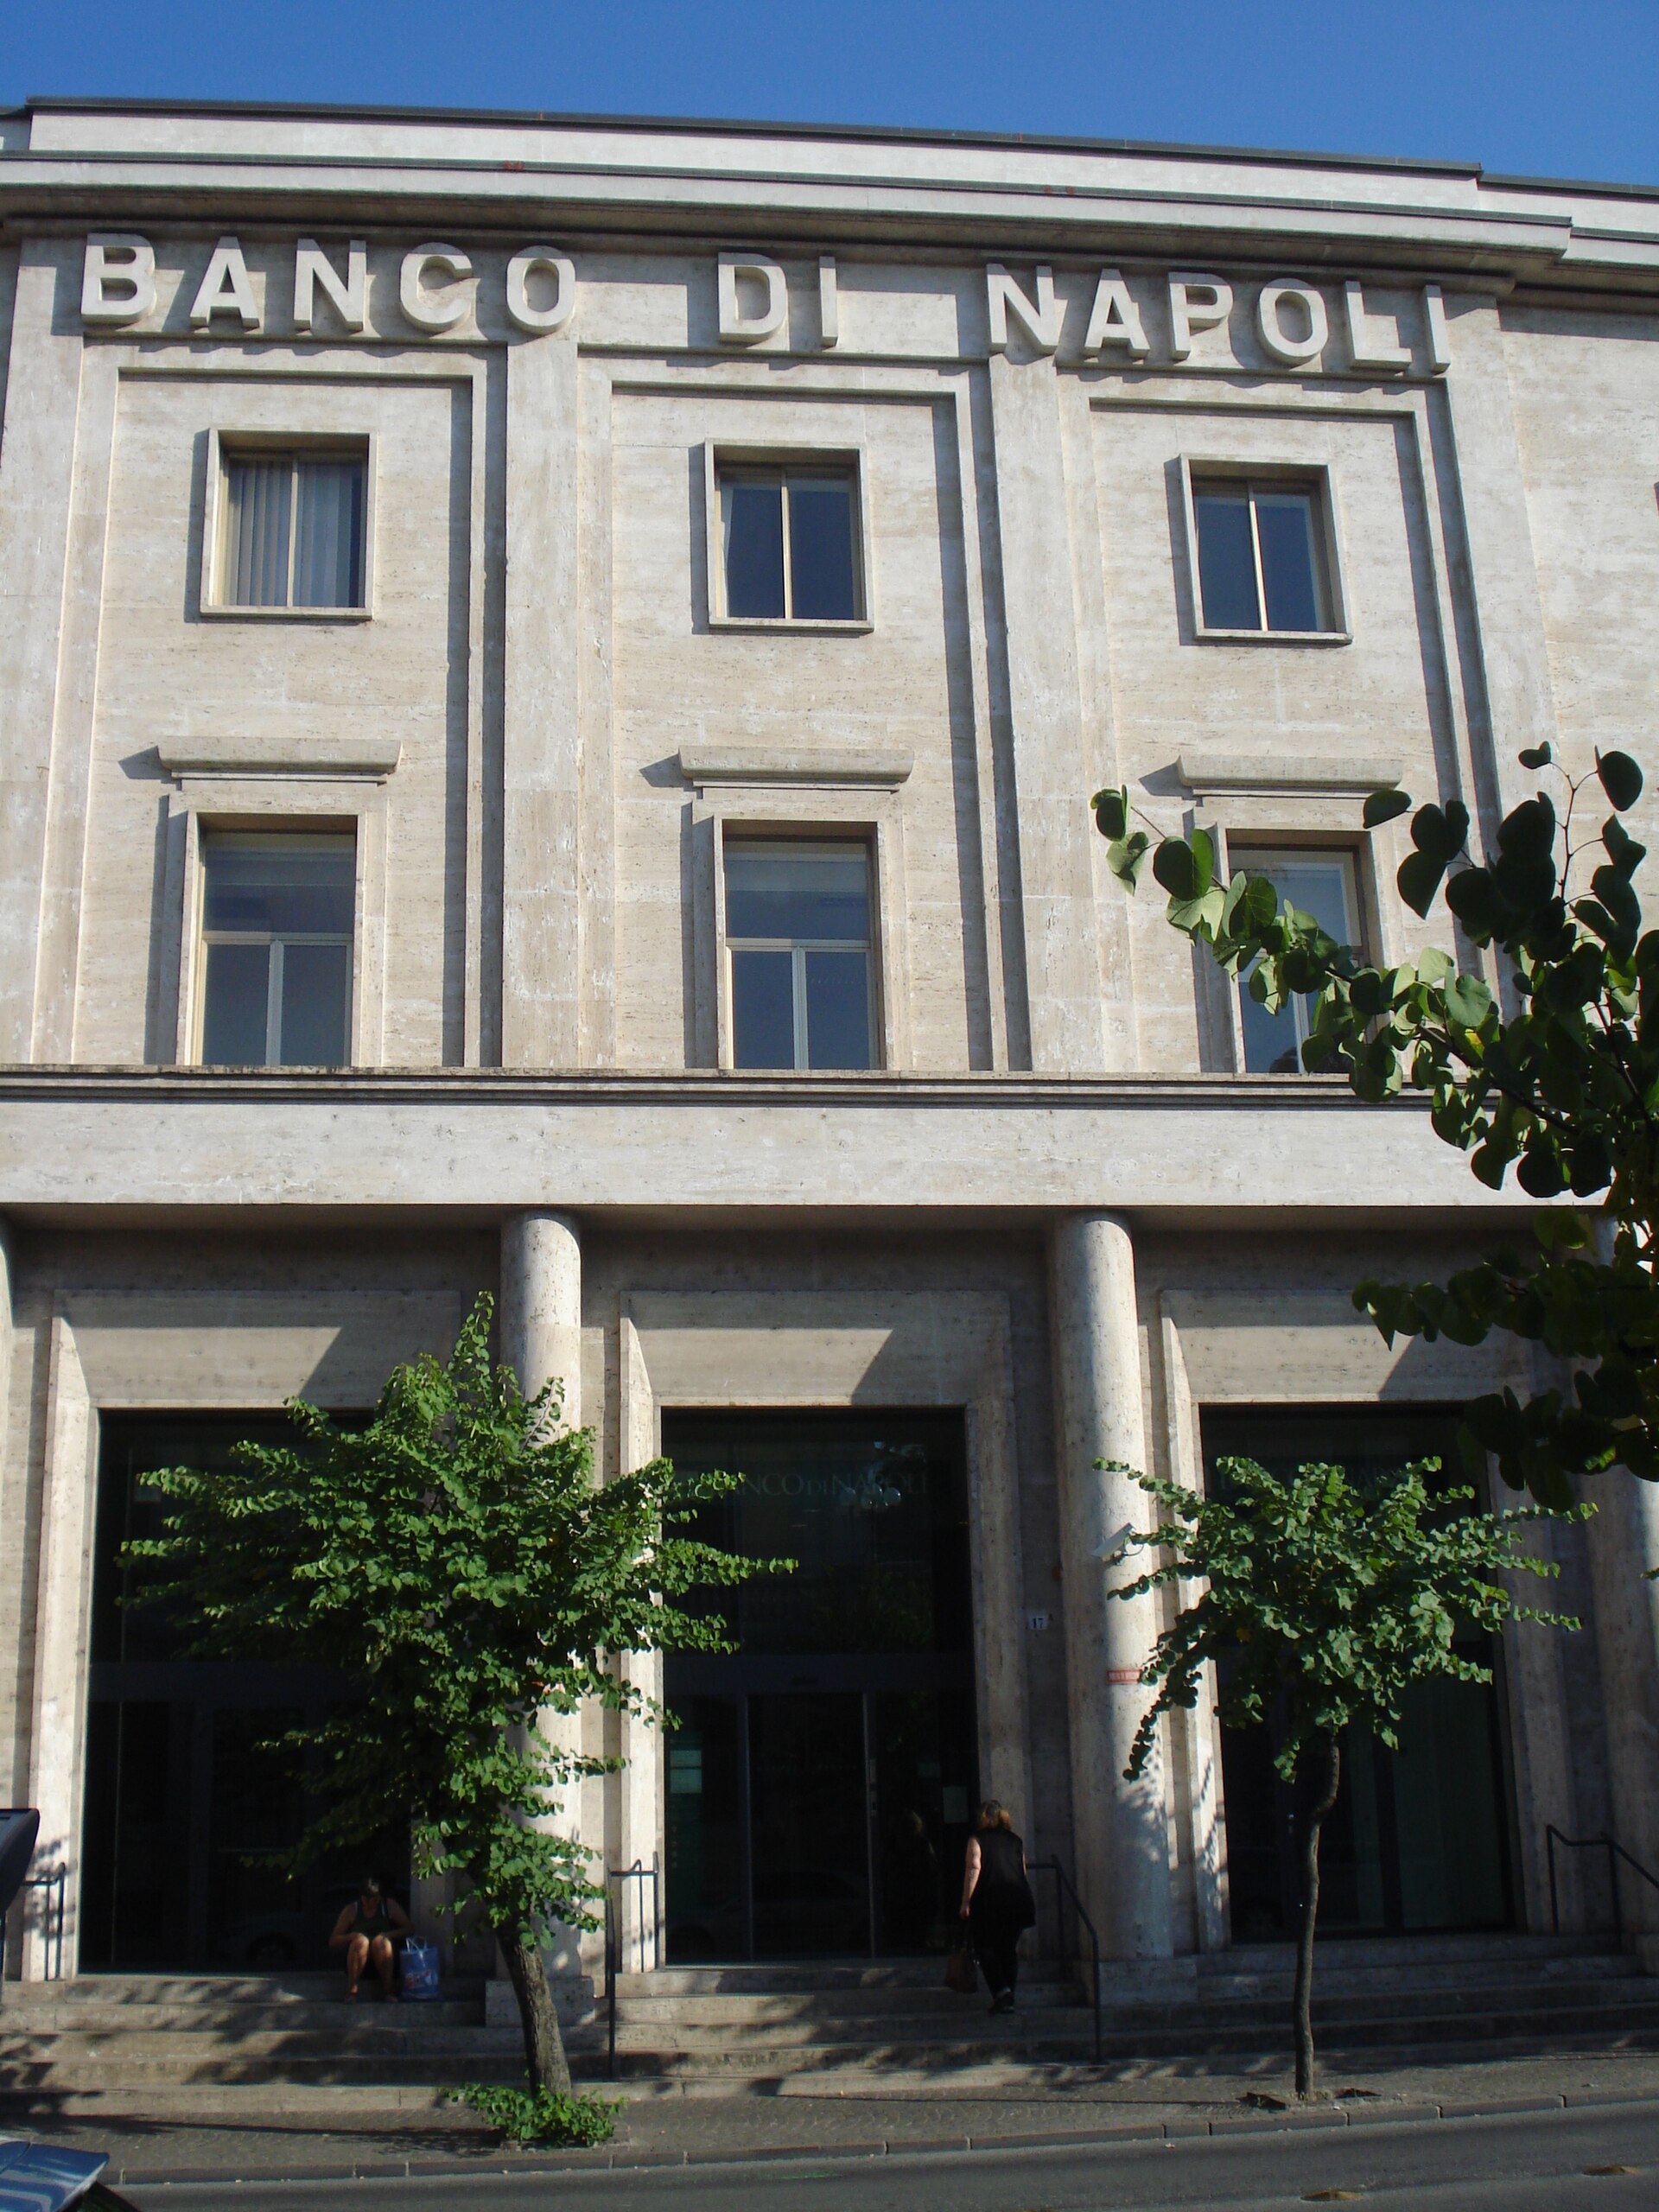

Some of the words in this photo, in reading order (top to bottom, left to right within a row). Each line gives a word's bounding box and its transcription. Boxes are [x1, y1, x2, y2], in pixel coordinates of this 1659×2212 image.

[80, 232, 576, 335] BANCO
[718, 251, 839, 346] DI
[986, 263, 1452, 373] NAPOLI
[719, 1471, 805, 1496] NCO
